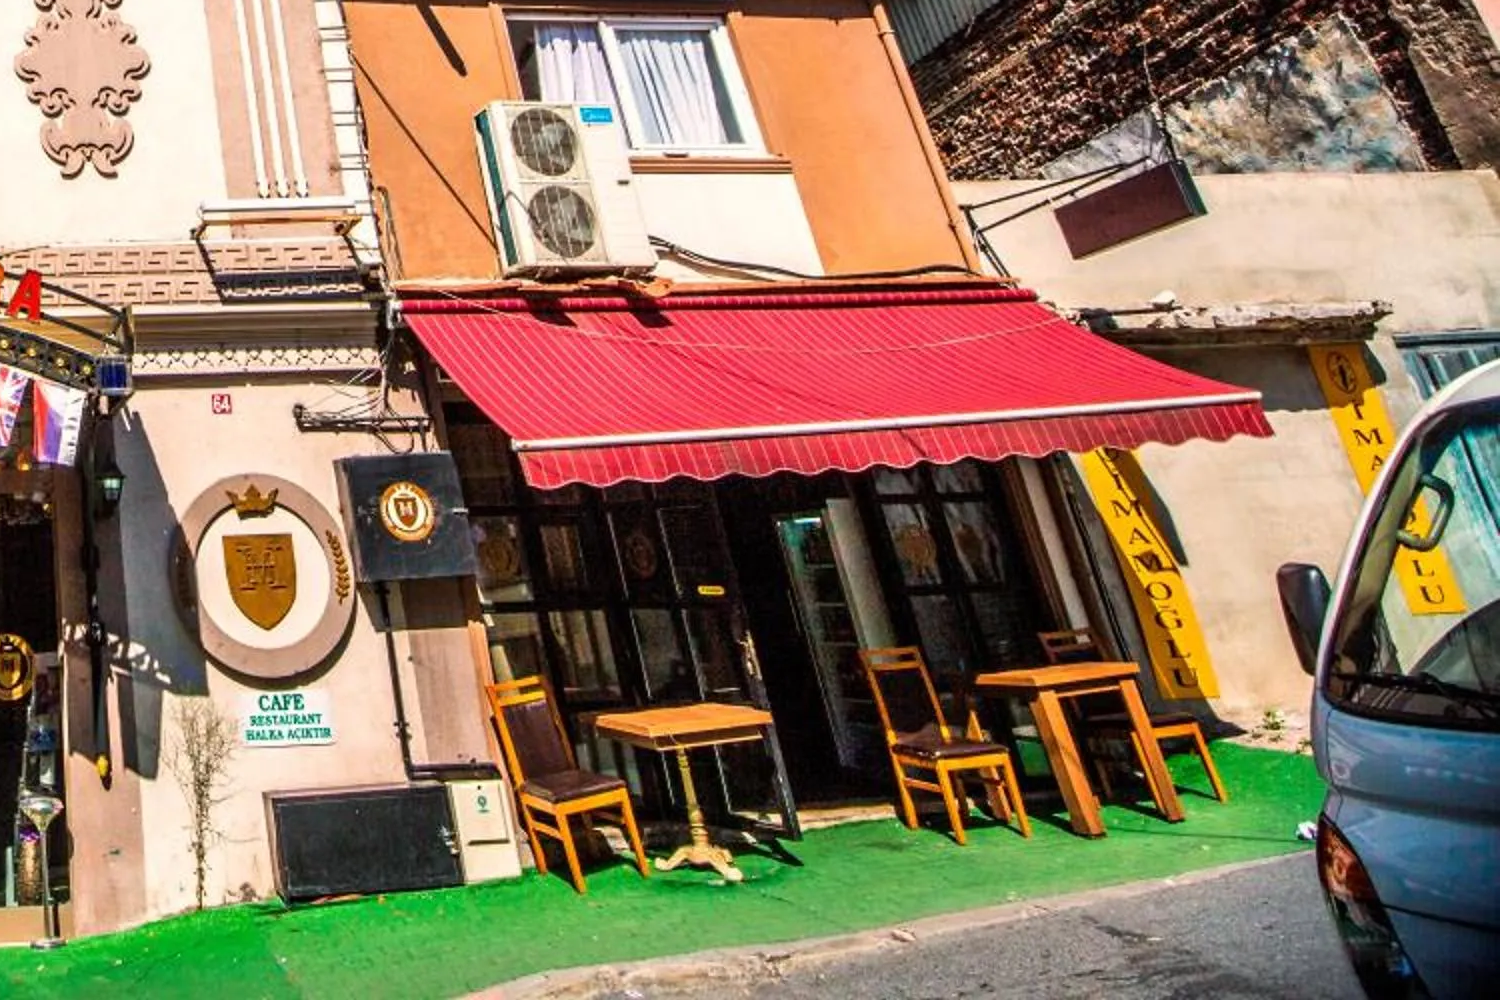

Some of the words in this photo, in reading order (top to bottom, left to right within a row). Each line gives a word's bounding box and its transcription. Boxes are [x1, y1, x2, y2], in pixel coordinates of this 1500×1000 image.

[258, 693, 305, 712] CAFE
[249, 712, 323, 727] RESTAURANT
[245, 729, 285, 741] HALKA
